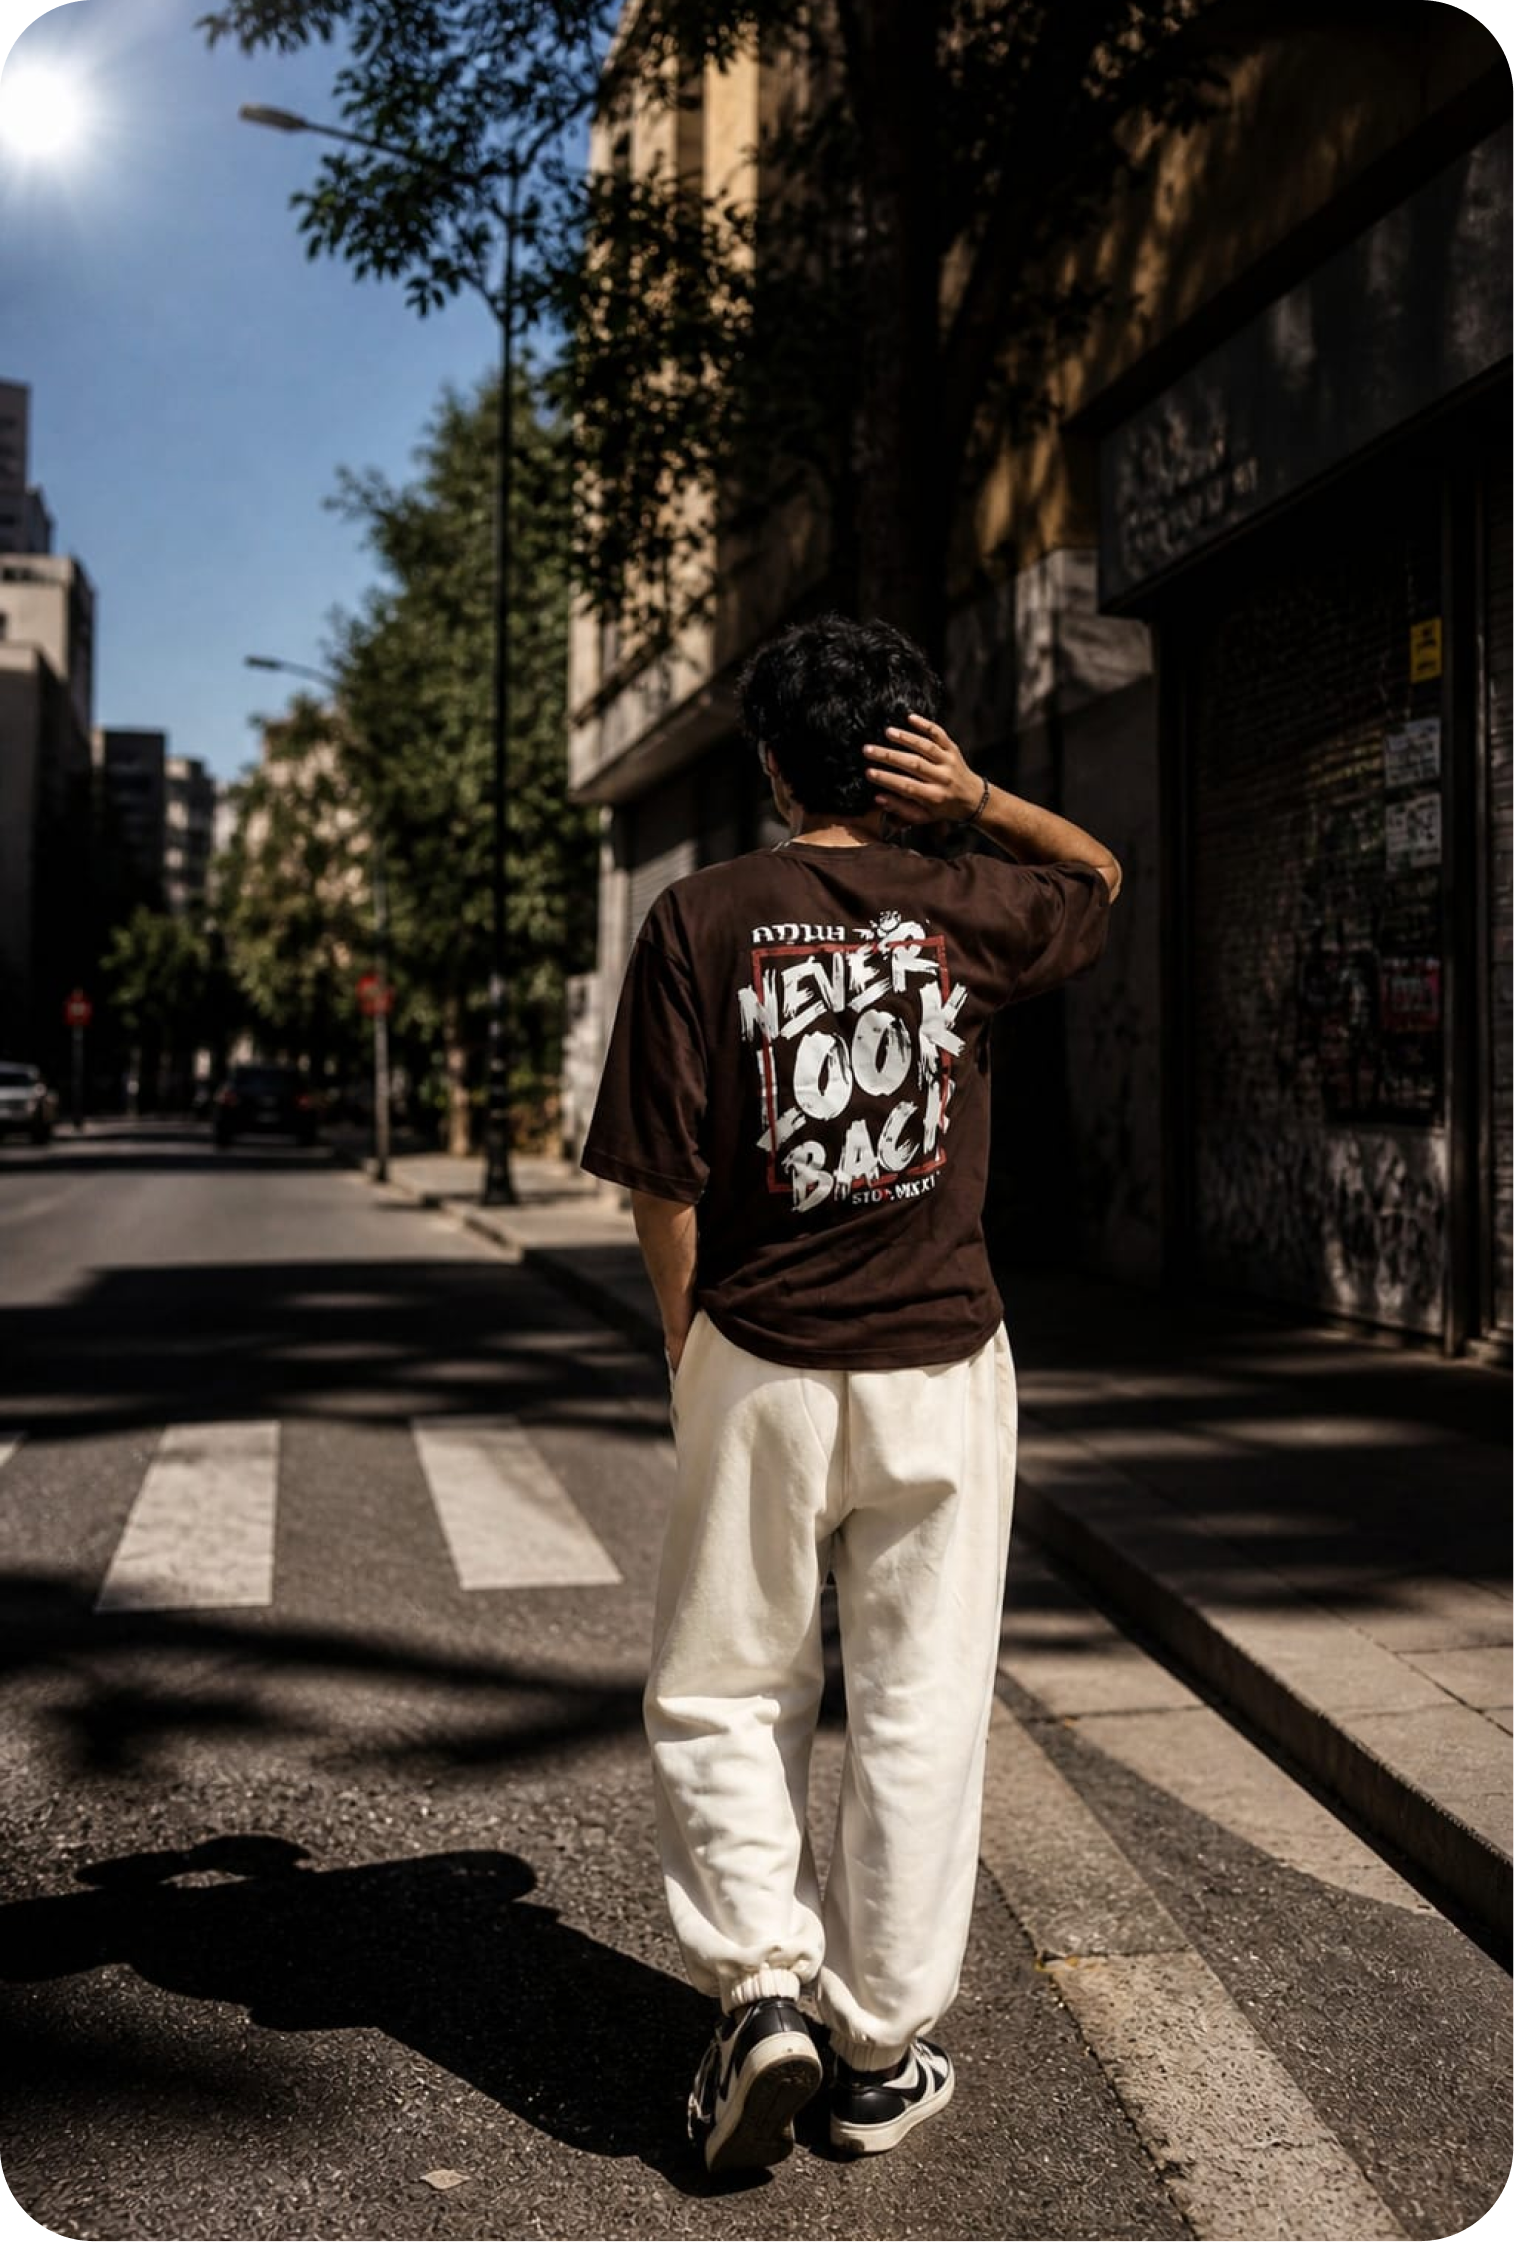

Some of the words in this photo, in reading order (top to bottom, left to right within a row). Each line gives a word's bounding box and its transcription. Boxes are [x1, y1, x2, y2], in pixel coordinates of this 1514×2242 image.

[738, 921, 940, 1042] NEVER
[756, 981, 968, 1152] LOOK
[781, 1079, 956, 1213] BACK
